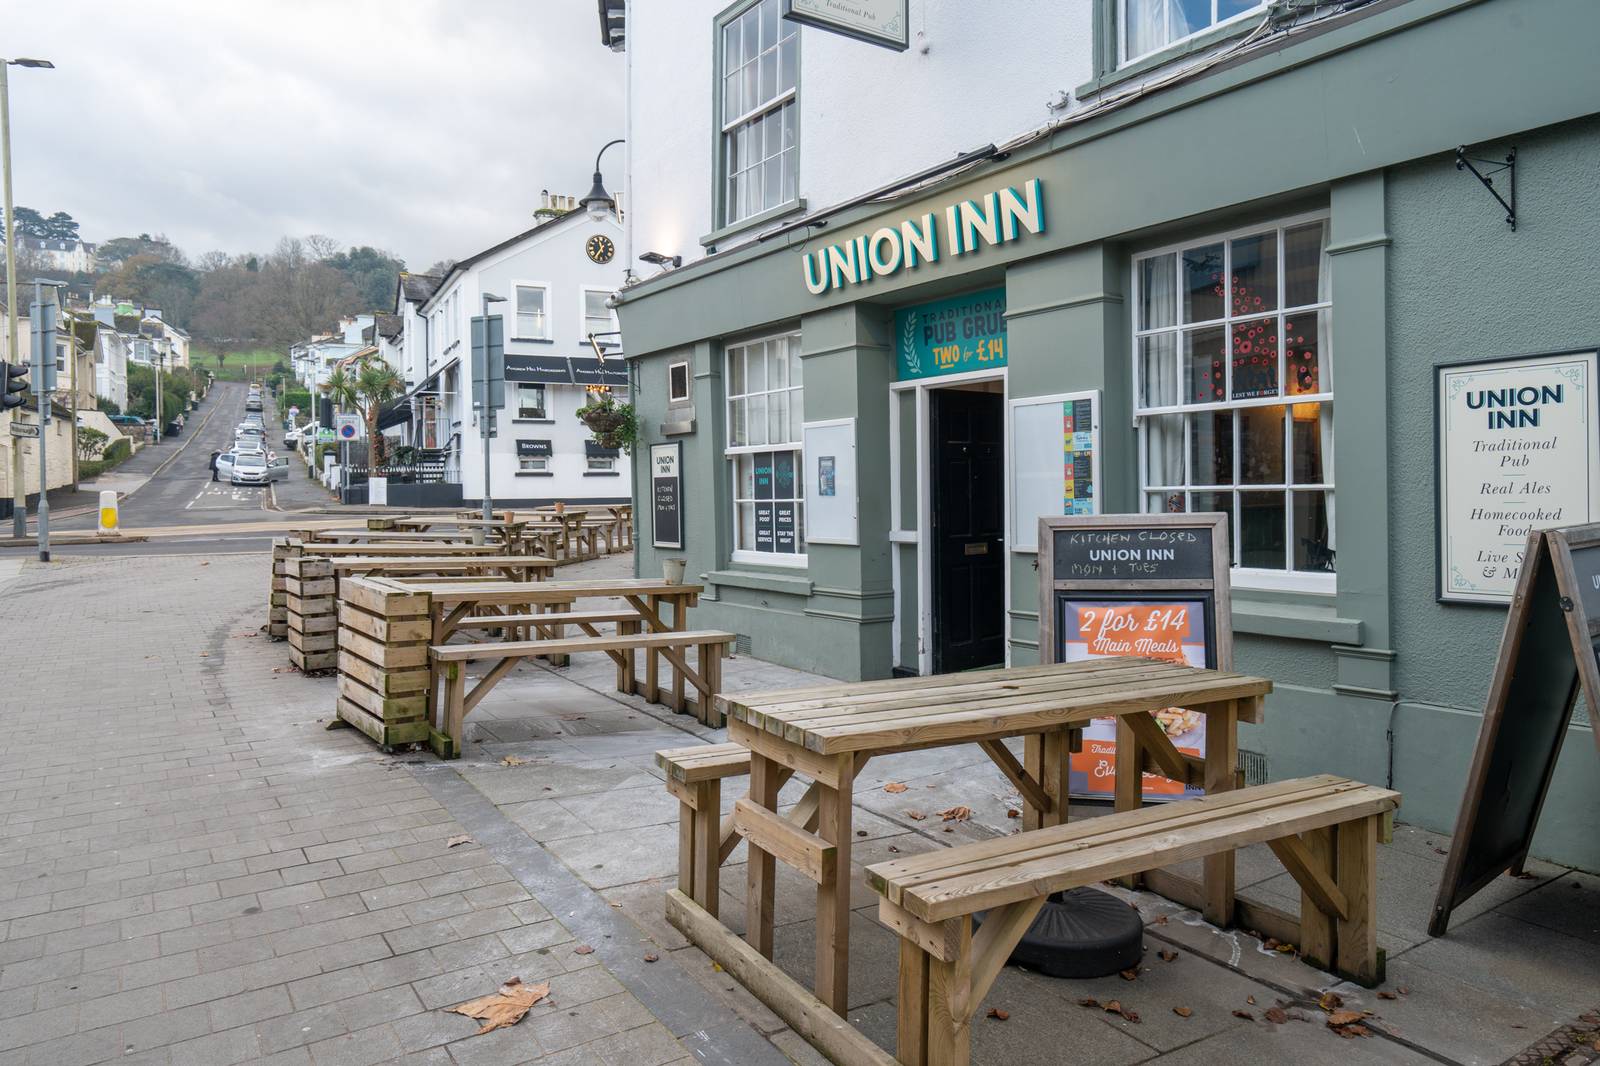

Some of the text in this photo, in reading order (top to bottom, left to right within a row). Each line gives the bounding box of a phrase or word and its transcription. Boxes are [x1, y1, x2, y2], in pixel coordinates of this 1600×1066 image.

[826, 0, 876, 20] Traditional Pub
[802, 178, 1045, 295] UNION INN
[922, 299, 1003, 324] TRADITIONA
[924, 319, 956, 346] PUB
[933, 337, 1003, 366] TWO for £14
[1467, 384, 1563, 410] UNION
[1488, 408, 1540, 430] INN
[1473, 436, 1557, 452] Traditional
[656, 456, 674, 464] UNION
[1500, 454, 1530, 467] Pub
[660, 465, 671, 473] INN
[1480, 481, 1551, 495] Real Ales
[1470, 507, 1562, 520] Homecooked
[1070, 531, 1197, 545] KITCHEN CLOSED
[1089, 549, 1175, 561] UNION INN
[1476, 550, 1509, 563] Live
[1071, 562, 1103, 576] MON
[1128, 562, 1159, 573] TUES
[1482, 566, 1497, 578] &
[1080, 608, 1186, 641] 2 for £14
[1093, 638, 1179, 655] Main Meals
